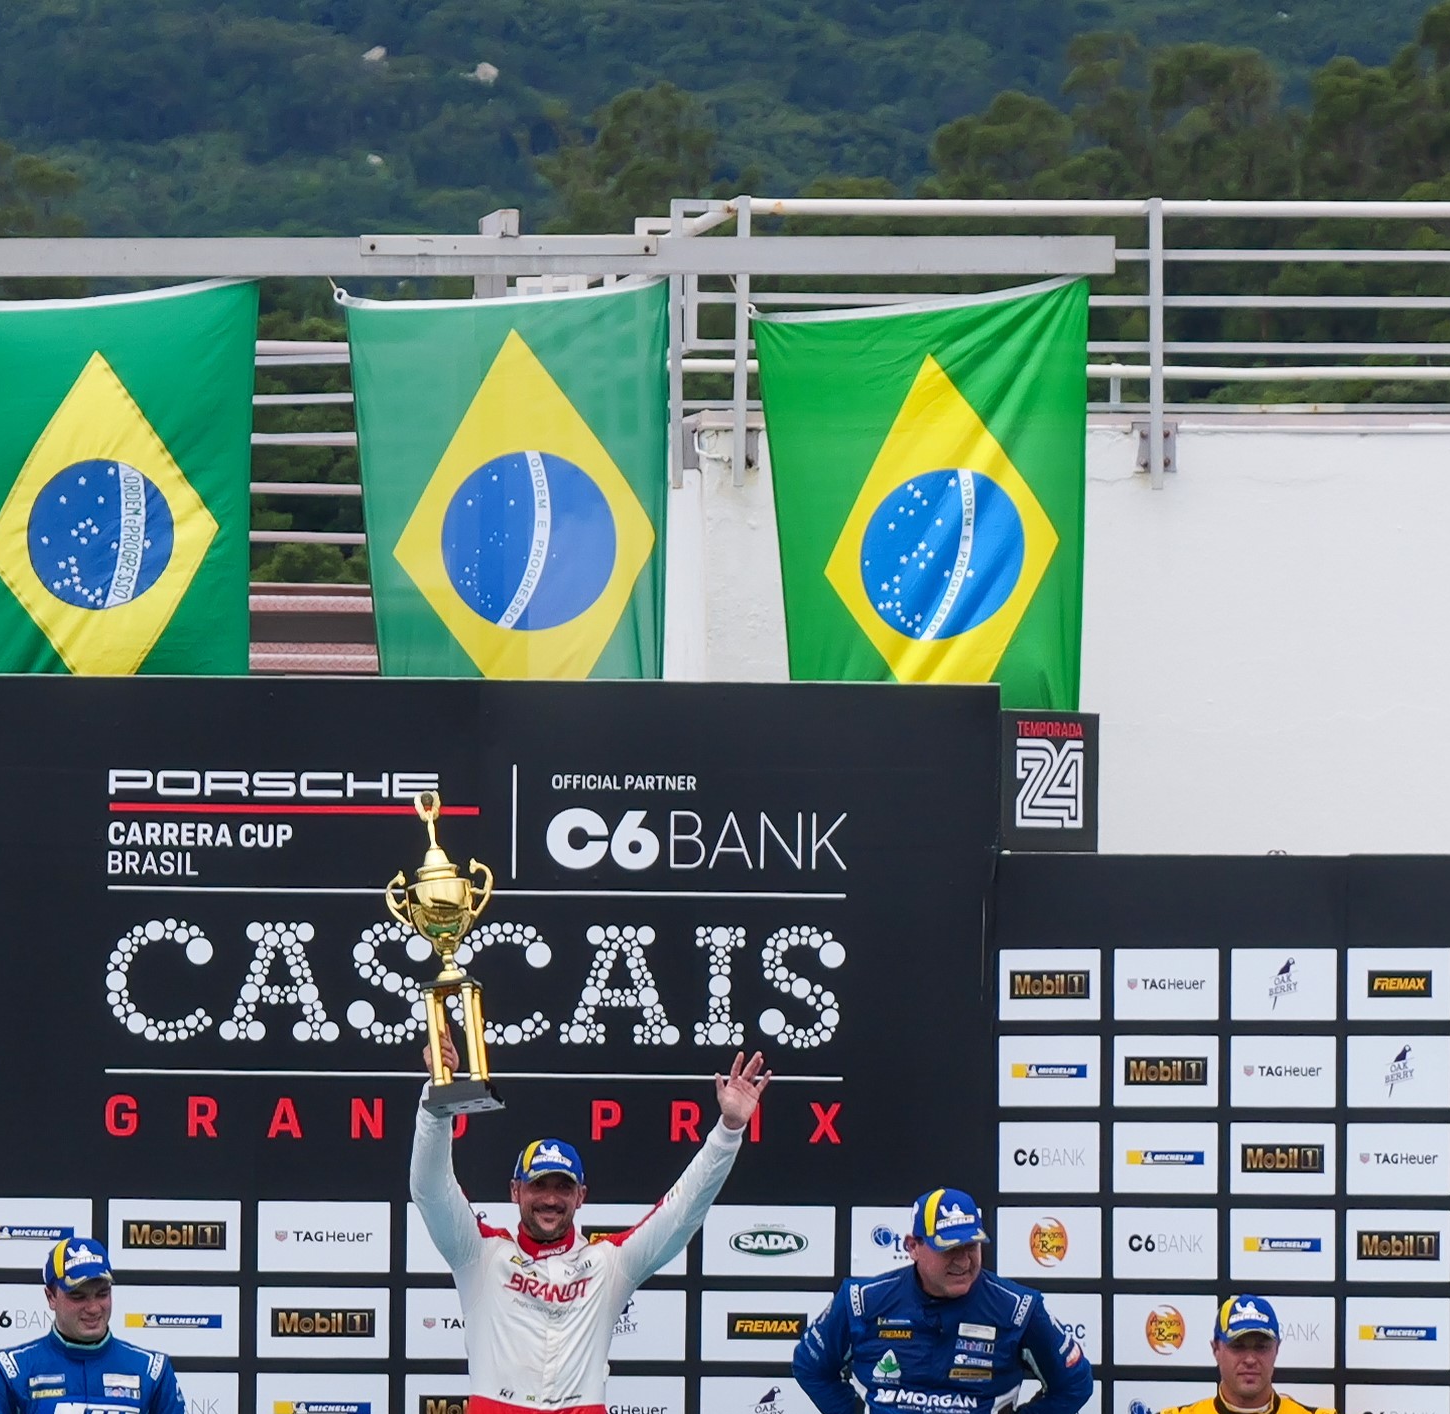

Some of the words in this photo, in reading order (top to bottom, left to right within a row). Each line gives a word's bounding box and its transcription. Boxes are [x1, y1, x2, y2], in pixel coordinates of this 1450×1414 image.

[530, 457, 548, 510] ORDEM
[962, 478, 973, 527] ORDEM
[536, 520, 547, 529] E
[504, 539, 545, 624] PROGRESSO
[1017, 721, 1083, 737] TEMPORADA
[108, 769, 439, 798] PORSCHE
[552, 775, 621, 790] OFFICIAL
[625, 775, 696, 790] PARTNER
[1016, 738, 1083, 828] 24
[108, 822, 233, 847] CARRERA
[239, 824, 292, 847] CUP
[108, 851, 198, 875] BRASIL
[105, 918, 846, 1049] CASCAIS
[1374, 978, 1425, 990] FREMAX
[105, 1094, 466, 1139] GRAN
[592, 1101, 842, 1144] PRIX
[12, 1226, 61, 1237] MICHELIN
[130, 1224, 193, 1245] Mobil
[738, 1234, 798, 1251] SADA
[160, 1317, 209, 1325] MICHELIN
[279, 1312, 342, 1333] Mobil
[735, 1320, 799, 1333] FREMAX
[309, 1402, 358, 1412] MICHELIN
[896, 1388, 978, 1409] MORGAN
